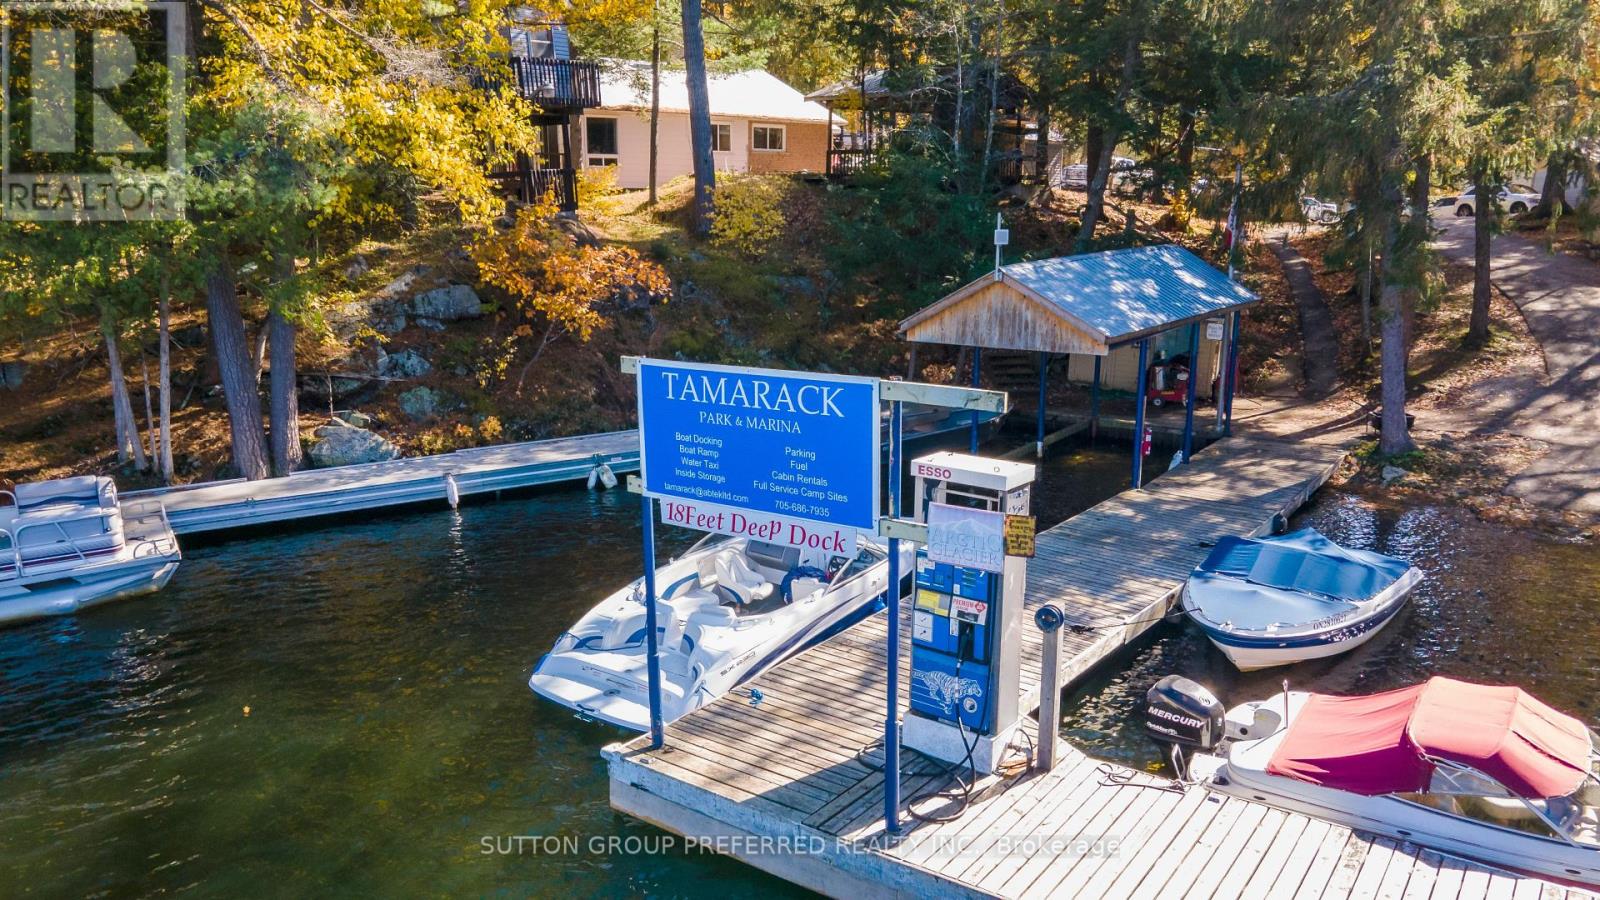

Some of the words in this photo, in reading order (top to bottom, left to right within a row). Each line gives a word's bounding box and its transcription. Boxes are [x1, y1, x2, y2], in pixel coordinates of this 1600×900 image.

[661, 371, 845, 418] TAMARACK
[699, 411, 732, 427] PARK
[735, 418, 743, 427] &
[746, 417, 802, 434] MARINA
[675, 431, 692, 443] Boat
[693, 434, 723, 448] Docking
[679, 444, 696, 455] Boat
[697, 447, 719, 459] Ramp
[785, 446, 816, 461] Parking
[681, 456, 702, 467] Water
[703, 459, 719, 470] Taxi
[790, 460, 808, 471] Fuel
[675, 467, 696, 479] Inside
[697, 470, 726, 484] Storage
[771, 470, 795, 482] Cabin
[796, 473, 828, 487] Rentals
[917, 464, 952, 480] ESSO
[753, 480, 768, 490] Full
[769, 482, 799, 495] Service
[800, 487, 825, 500] Camp
[827, 490, 848, 503] Sites
[775, 499, 830, 517] 705-686-7935
[666, 502, 724, 531] 18Feet
[730, 512, 782, 541] Deep
[789, 523, 847, 553] Dock
[931, 542, 1001, 566] GLACIER
[1147, 706, 1207, 729] MERCURY
